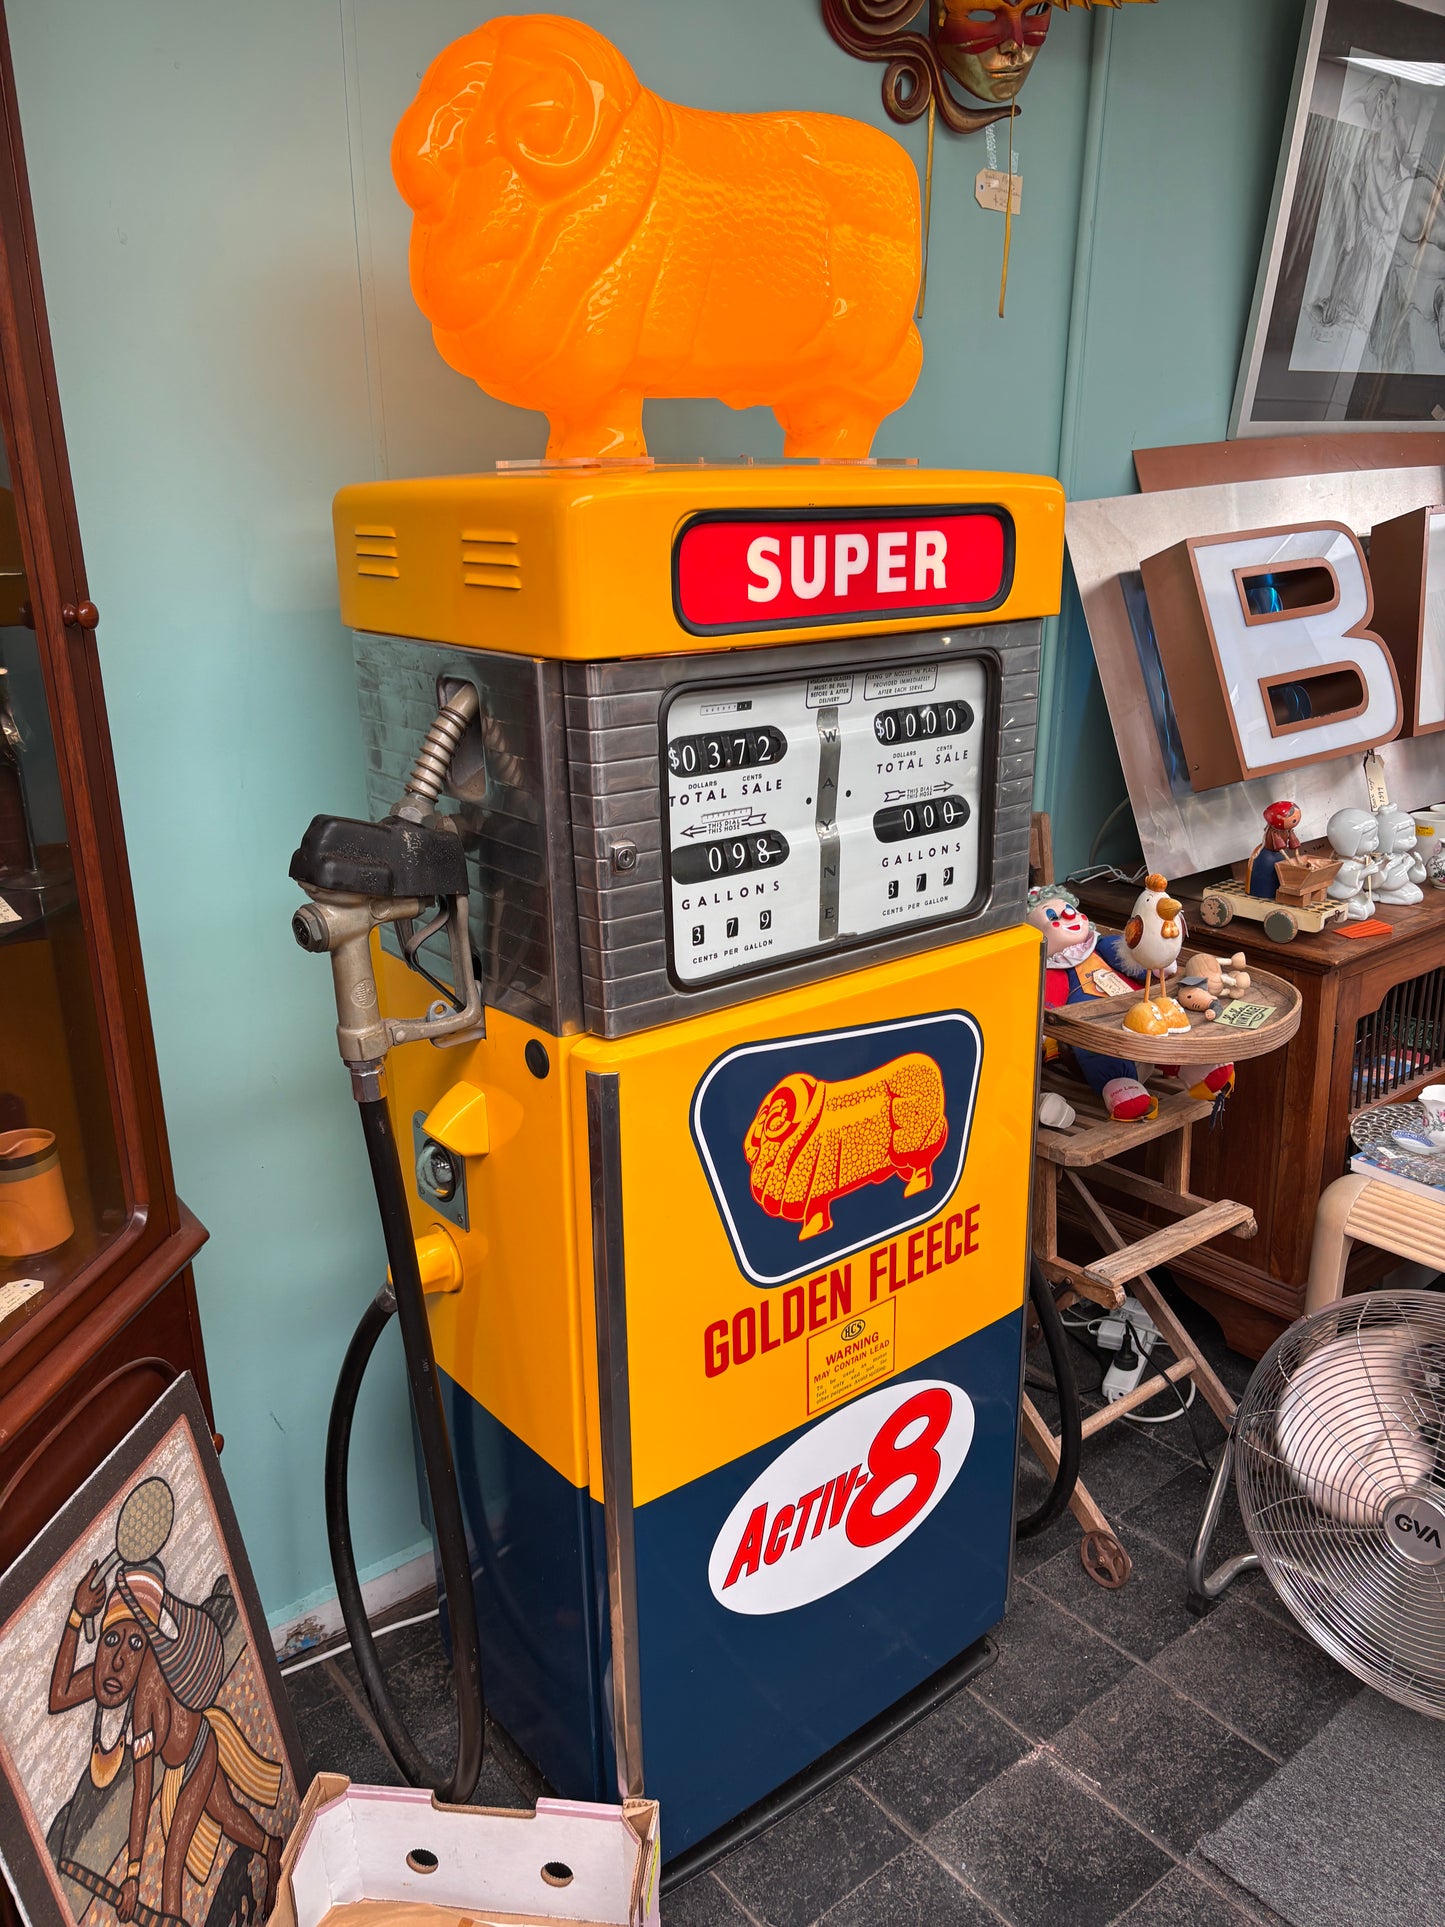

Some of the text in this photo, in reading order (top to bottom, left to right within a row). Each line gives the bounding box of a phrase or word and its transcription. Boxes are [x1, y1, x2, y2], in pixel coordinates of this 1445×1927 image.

[746, 530, 948, 603] SUPER
[1187, 519, 1404, 781] B
[873, 676, 930, 688] PROVIDED IMMEDIATELY
[894, 670, 913, 678] NOZZLE
[922, 666, 937, 675] PLACE
[810, 690, 828, 698] BEFORE
[835, 688, 849, 696] AFTER
[878, 684, 923, 696] AFTER EACH SERVE
[876, 750, 969, 774] TOTAL SALE
[893, 744, 953, 759] DOLLARS CENTS
[669, 779, 783, 807] TOTAL SALE
[688, 773, 763, 790] DOLLARS CENTS
[708, 819, 741, 830] THIS DIAL
[821, 730, 838, 919] WAYNE
[903, 801, 954, 832] 000
[708, 827, 722, 835] THIS
[708, 838, 770, 873] 098
[881, 842, 961, 868] GALLONS
[681, 880, 780, 911] GALLONS
[882, 896, 949, 917] CENTS PER GALLON
[692, 953, 718, 965] CENTS
[723, 947, 739, 957] PER
[743, 939, 774, 952] GALLON
[704, 1204, 980, 1379] GOLDEN FLEECE
[843, 1322, 863, 1339] HCS
[813, 1339, 890, 1384] MAY CONTAIN LEAD
[826, 1331, 879, 1366] WARNING
[816, 1389, 827, 1399] fuel
[833, 1380, 845, 1390] only
[850, 1372, 861, 1380] and
[842, 1368, 855, 1378] used
[816, 1395, 830, 1405] other
[853, 1375, 868, 1385] Avoid
[1394, 1513, 1442, 1550] GVA
